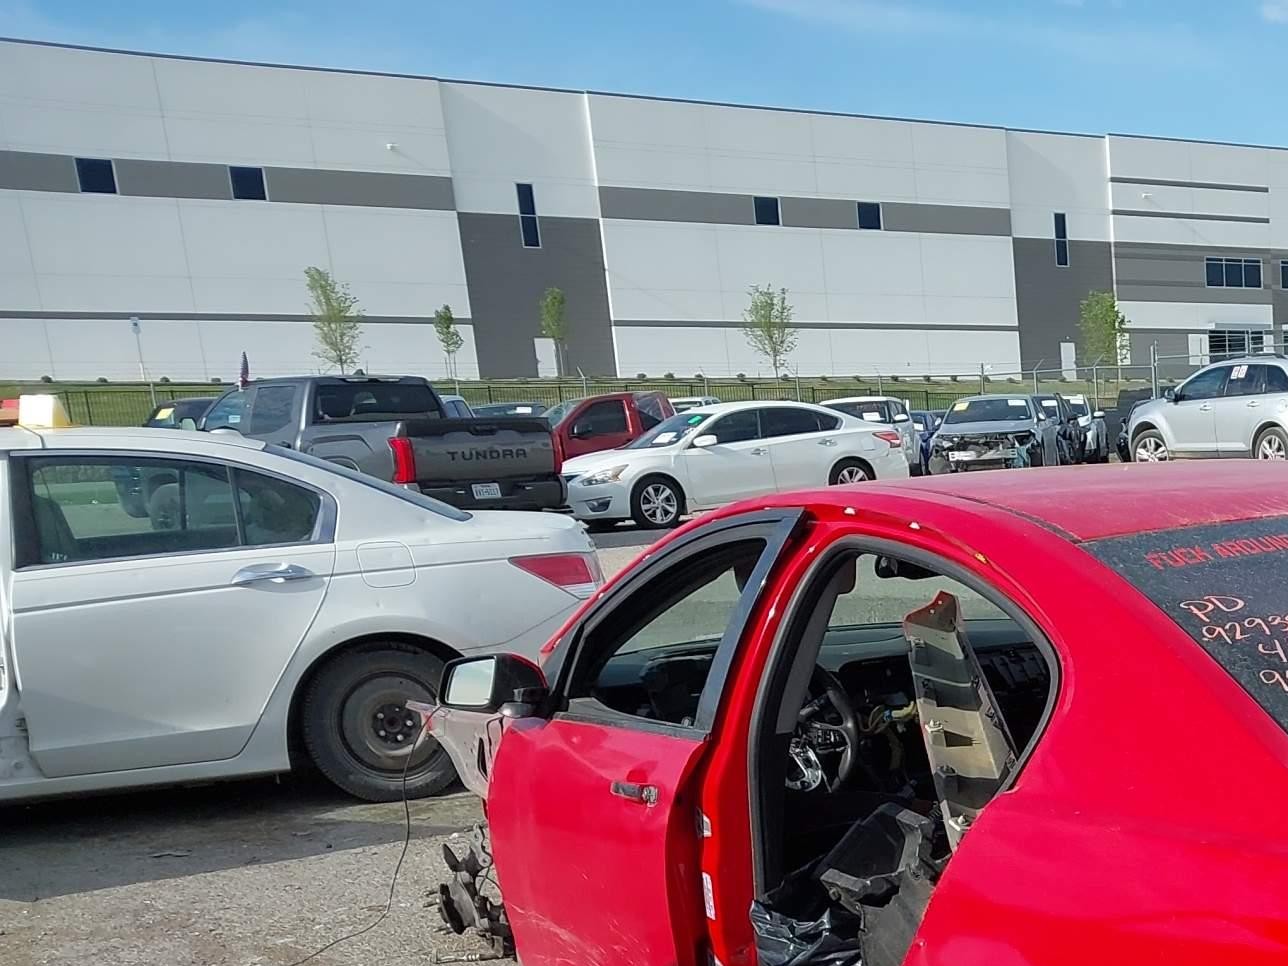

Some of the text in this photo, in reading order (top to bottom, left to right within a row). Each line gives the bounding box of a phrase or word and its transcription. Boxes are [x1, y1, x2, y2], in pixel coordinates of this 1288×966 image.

[447, 448, 527, 462] TUNDRA
[1144, 545, 1213, 571] FUCK
[1179, 595, 1245, 622] PD
